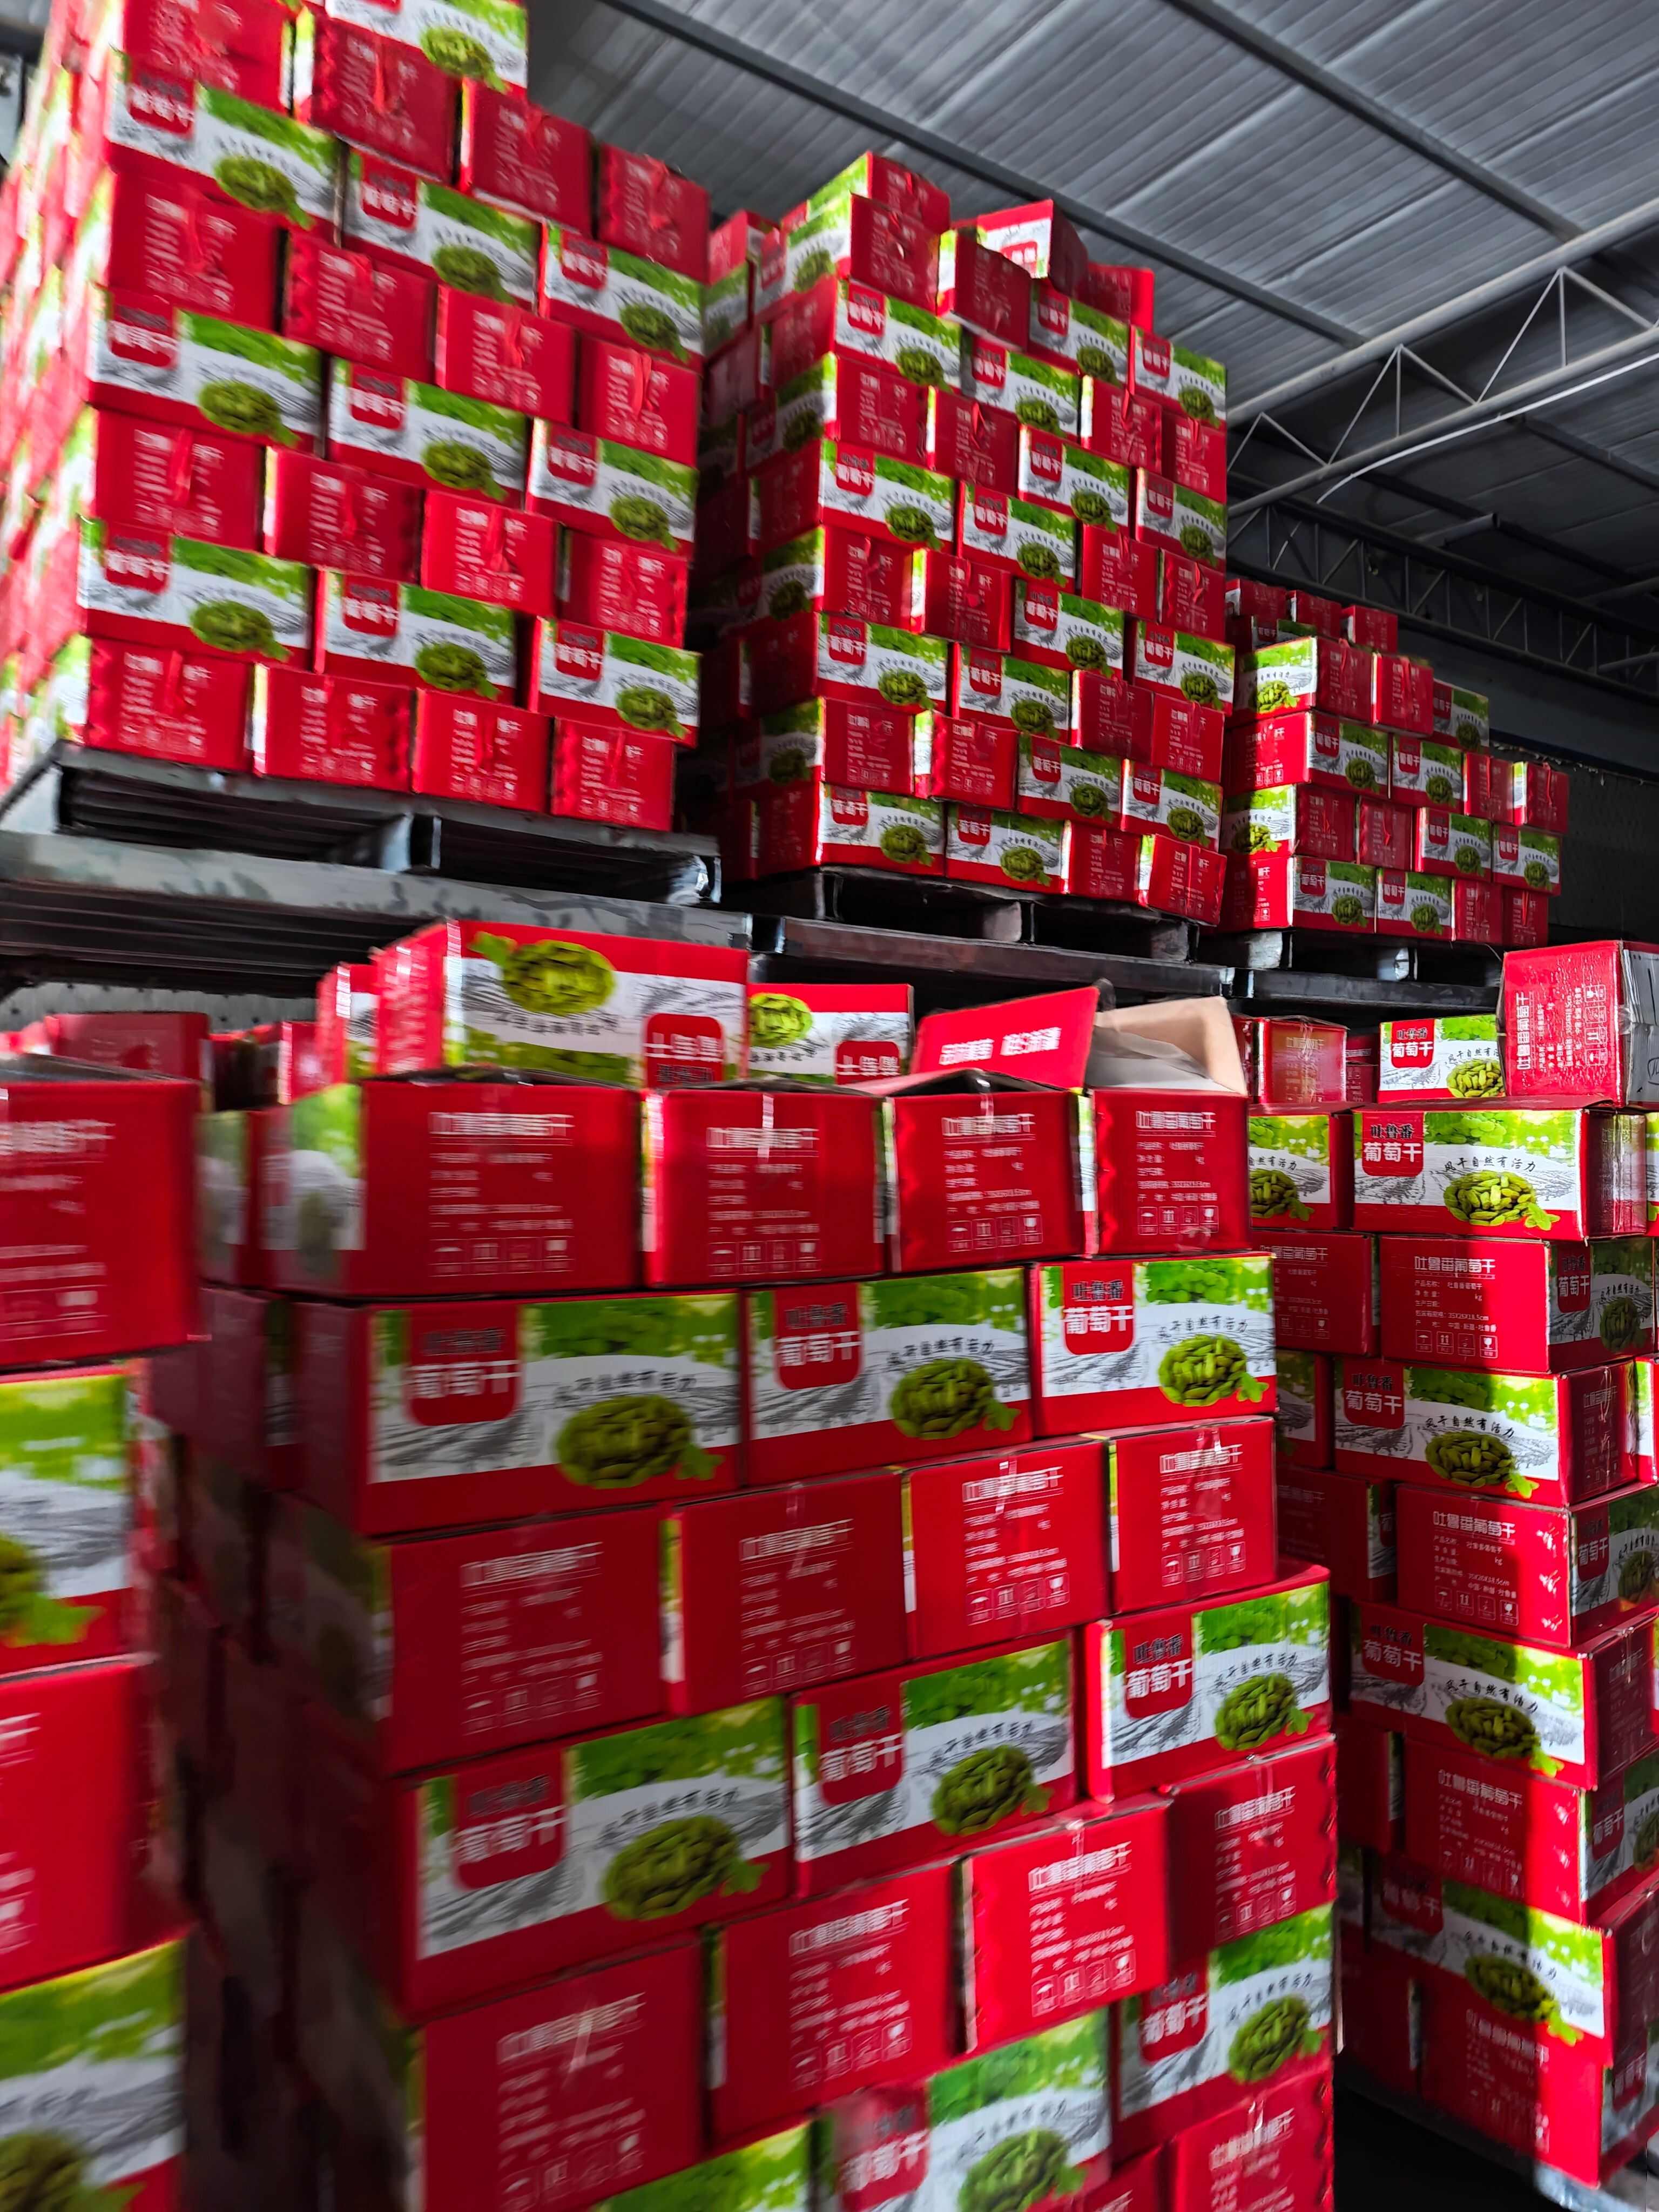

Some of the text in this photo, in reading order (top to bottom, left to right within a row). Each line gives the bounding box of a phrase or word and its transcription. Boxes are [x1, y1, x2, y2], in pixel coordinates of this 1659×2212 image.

[1397, 1028, 1427, 1040] 吐鲁番
[1516, 992, 1530, 1070] 吐鲁番葡萄干
[1391, 1041, 1433, 1058] 葡萄干
[1371, 1123, 1414, 1139] 吐鲁番
[1364, 1142, 1422, 1163] 葡萄干
[1444, 1154, 1537, 1174] 风干自然有活力
[1414, 1256, 1496, 1274] 吐鲁番葡萄干
[1073, 1279, 1124, 1300] 吐鲁番
[1558, 1274, 1590, 1297] 葡萄干
[1063, 1305, 1133, 1336] 葡萄干
[775, 1331, 861, 1367] 葡萄干
[1352, 1373, 1393, 1391] 吐鲁番
[1345, 1390, 1403, 1416] 葡萄干
[1433, 1511, 1515, 1539] 吐鲁番葡萄干
[1578, 1537, 1608, 1565] 葡萄干
[1363, 1639, 1422, 1673] 葡萄干
[1126, 1656, 1192, 1700] 葡萄干
[819, 1732, 904, 1782] 葡萄干
